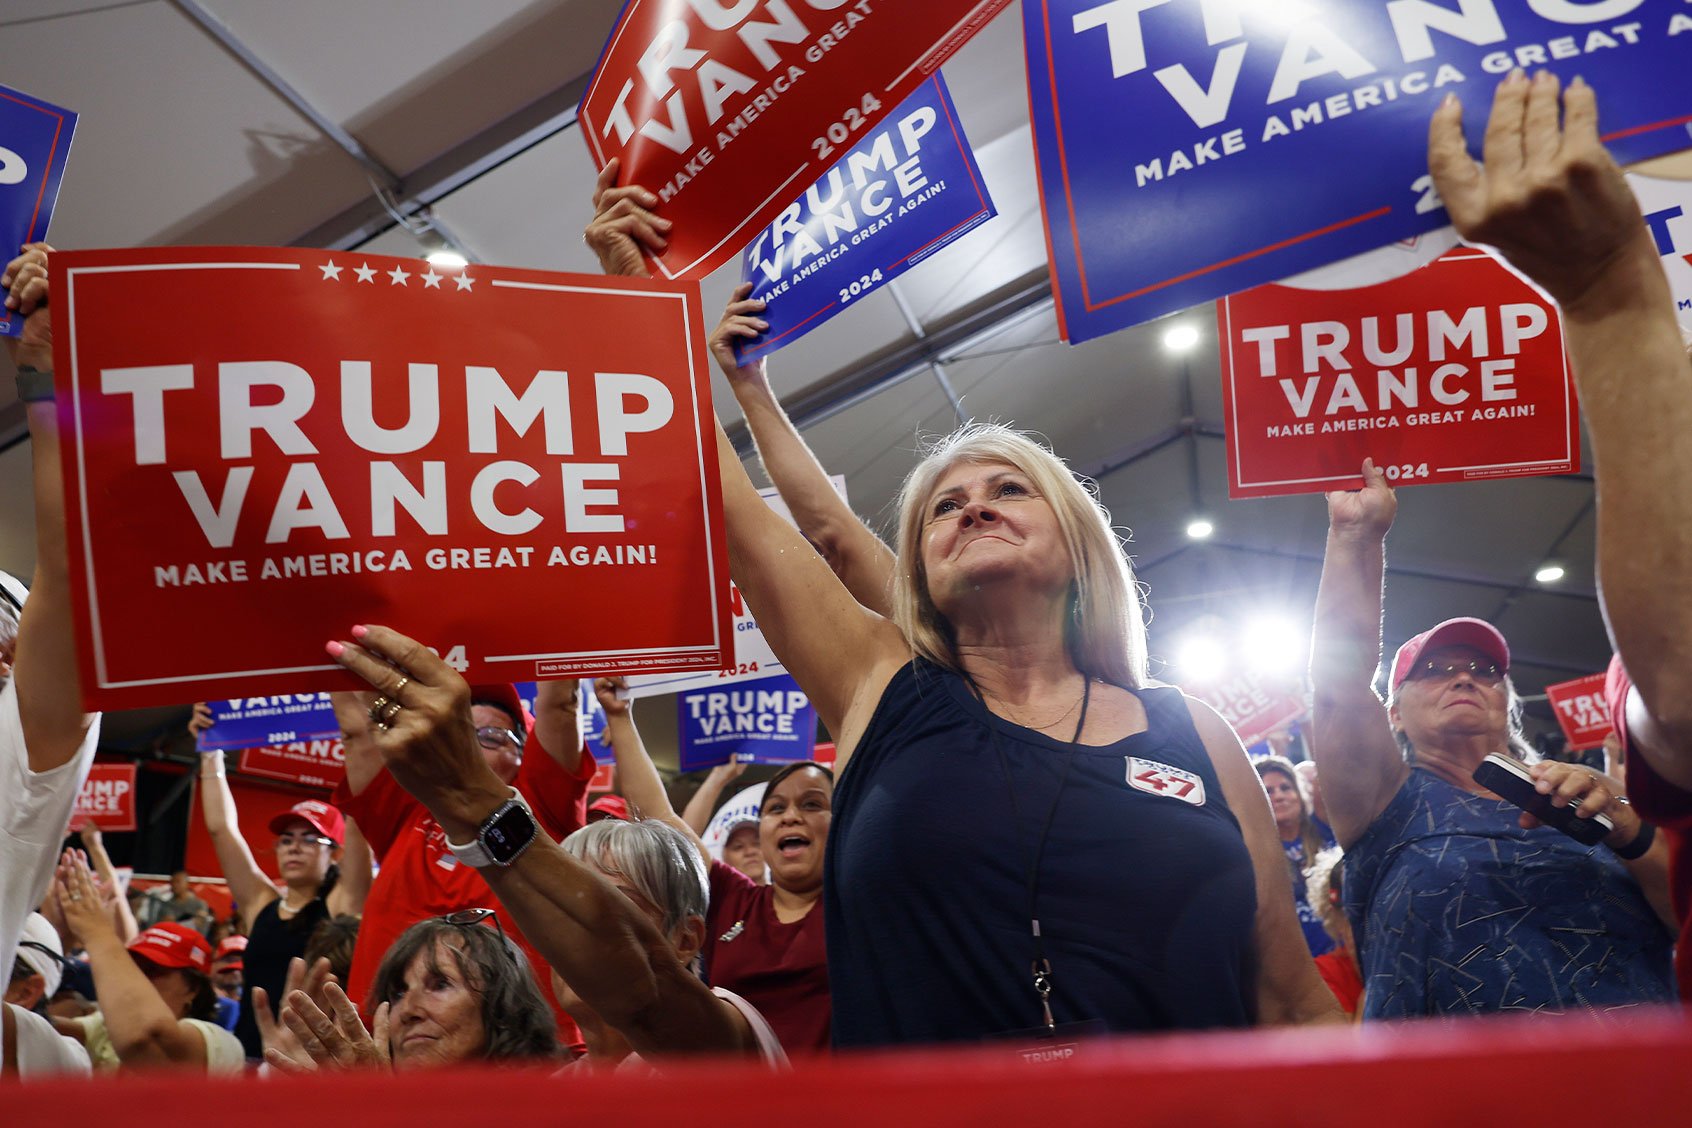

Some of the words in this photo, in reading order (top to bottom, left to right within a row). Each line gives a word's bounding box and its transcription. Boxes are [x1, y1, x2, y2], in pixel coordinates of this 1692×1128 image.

[657, 146, 716, 204] MAKE
[715, 65, 806, 151] AMERICA
[805, 0, 873, 64] GREAT
[811, 92, 882, 161] 2024
[1134, 128, 1247, 188] MAKE
[1262, 64, 1467, 143] AMERICA
[1480, 22, 1643, 75] GREAT
[748, 106, 937, 273] TRUMP
[760, 155, 928, 283] VANCE
[793, 243, 849, 285] AMERICA
[851, 213, 894, 246] GREAT
[898, 180, 947, 217] AGAIN!
[838, 268, 884, 303] 2024
[1242, 302, 1548, 378] TRUMP
[100, 360, 674, 466] TRUMP
[1279, 358, 1517, 418] VANCE
[1266, 421, 1315, 438] MAKE
[1321, 415, 1400, 434] AMERICA
[1406, 410, 1464, 426] GREAT
[1471, 404, 1535, 421] AGAIN!
[172, 460, 625, 548] VANCE
[154, 560, 249, 588] MAKE
[260, 549, 413, 580] AMERICA
[425, 546, 535, 570] GREAT
[547, 545, 657, 567] AGAIN!
[718, 661, 759, 678] 2024
[685, 689, 809, 719] TRUMP
[699, 713, 794, 736] VANCE
[1134, 770, 1197, 798] 47
[1022, 1048, 1074, 1065] TRUMP
